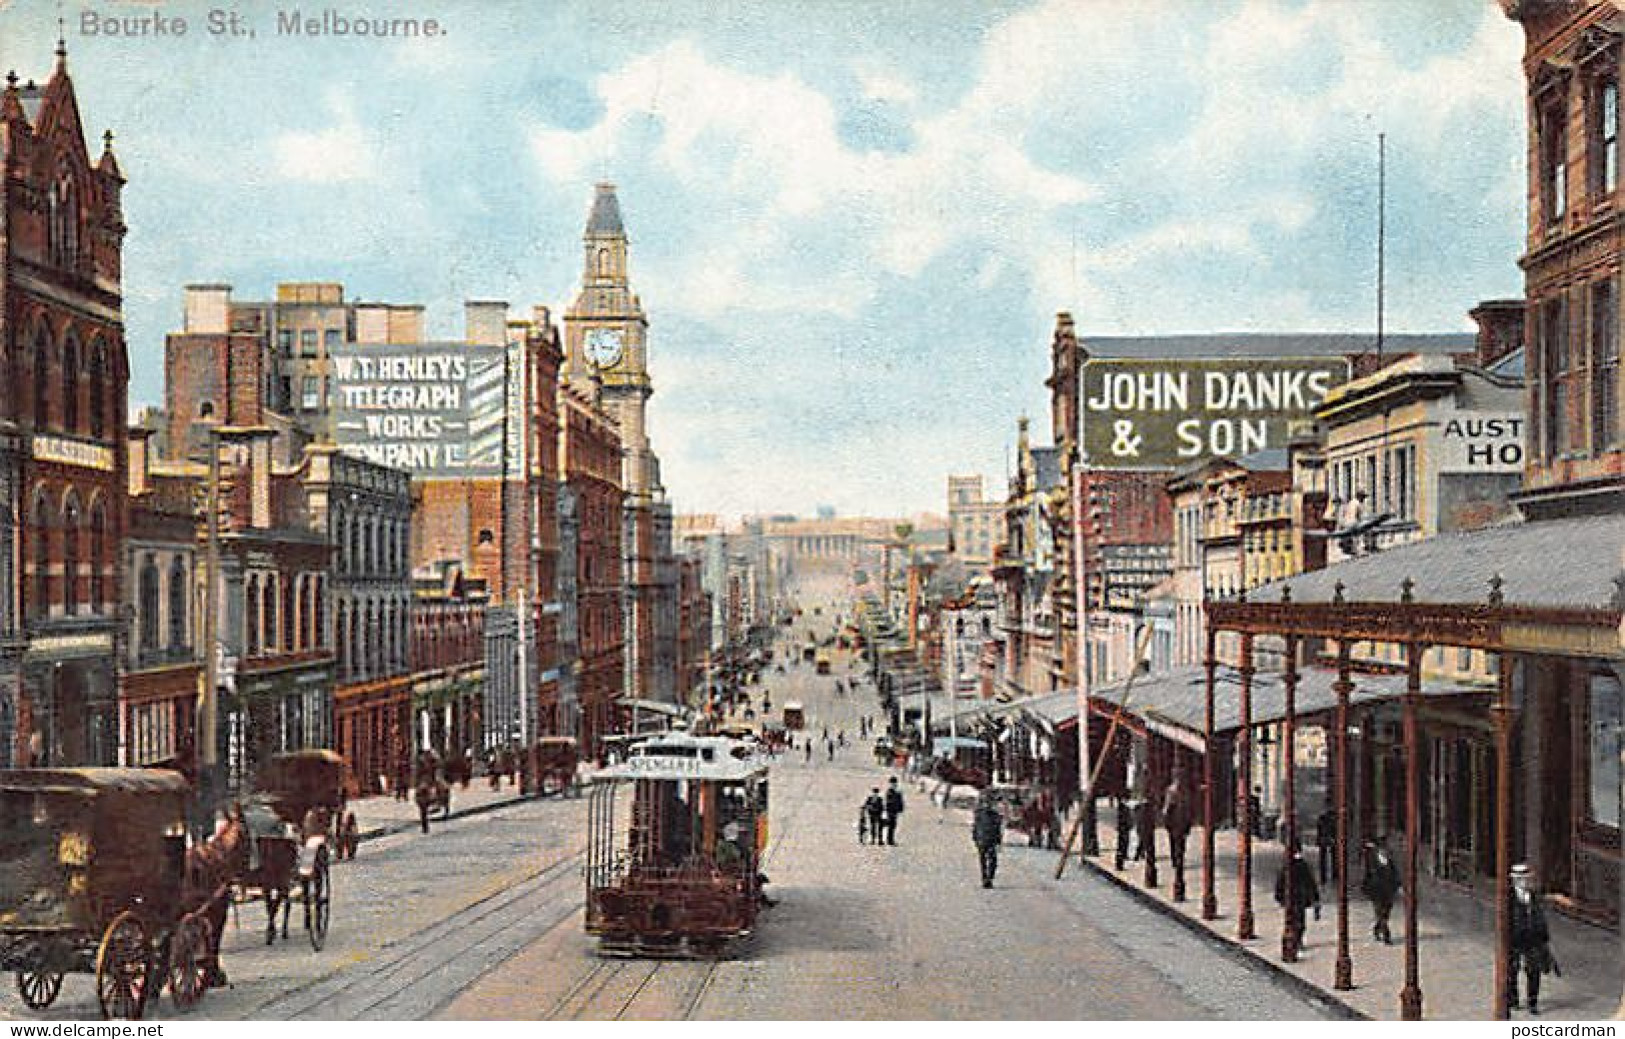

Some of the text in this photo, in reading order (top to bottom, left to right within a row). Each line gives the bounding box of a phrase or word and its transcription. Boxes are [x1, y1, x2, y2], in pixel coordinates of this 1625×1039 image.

[342, 383, 460, 409] TELEGRAPH
[1088, 370, 1331, 411] JOHN DANKS
[365, 415, 443, 438] WORKS
[1111, 420, 1142, 457] &
[1176, 419, 1267, 456] SON
[1444, 419, 1523, 437] AUST
[1468, 443, 1522, 465] HO
